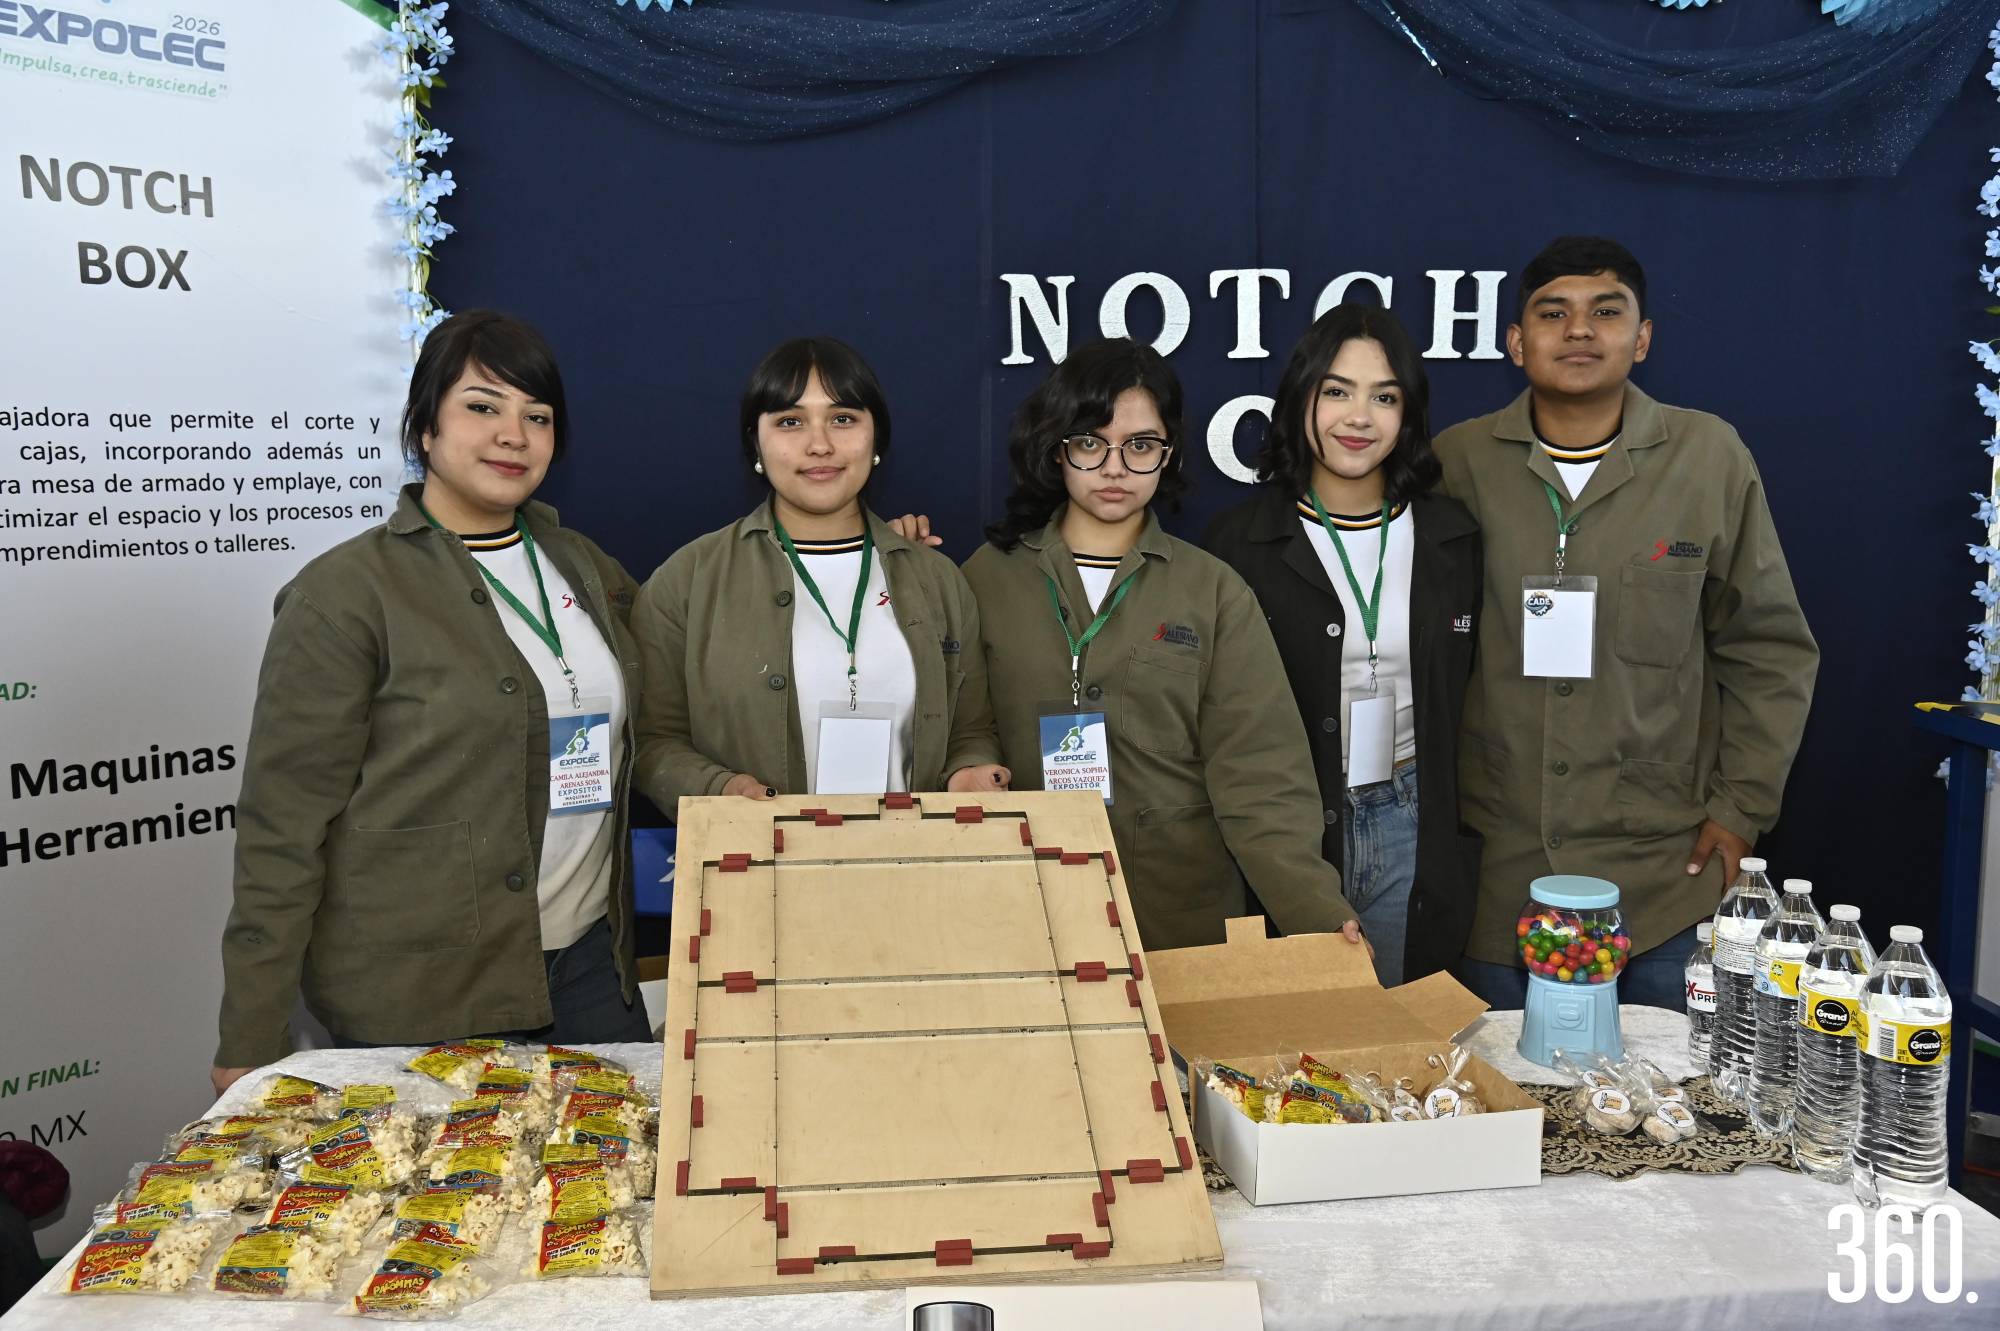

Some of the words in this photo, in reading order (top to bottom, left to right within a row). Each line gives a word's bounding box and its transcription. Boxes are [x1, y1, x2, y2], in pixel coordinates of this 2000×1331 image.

[172, 15, 220, 36] 2026
[0, 1, 226, 72] EXPOTEC
[0, 50, 77, 78] mpulsa,
[80, 66, 124, 85] crea,
[19, 153, 215, 218] NOTCH
[78, 241, 191, 292] BOX
[0, 406, 90, 433] ajadora
[109, 412, 152, 433] que
[170, 411, 254, 433] permite
[271, 411, 288, 430] el
[305, 414, 355, 431] corte
[370, 416, 381, 434] y
[20, 443, 87, 466] cajas,
[105, 441, 252, 467] incorporando
[267, 441, 344, 460] además
[358, 446, 381, 460] un
[32, 476, 95, 494] mesa
[105, 474, 133, 494] de
[141, 472, 225, 493] armado
[233, 476, 244, 496] y
[252, 472, 342, 495] emplaye,
[349, 475, 382, 490] con
[88, 506, 108, 527] el
[118, 504, 201, 528] espacio
[210, 507, 221, 527] y
[229, 503, 258, 523] los
[266, 503, 354, 526] procesos
[361, 504, 383, 519] en
[195, 539, 209, 554] o
[214, 533, 296, 554] talleres.
[559, 756, 600, 766] EXPOTEC
[1053, 753, 1097, 762] EXPOTEC
[10, 744, 236, 800] Maquinas
[550, 773, 574, 782] CAMILA
[575, 769, 609, 779] ALEJANDRA
[1044, 768, 1080, 776] VERONICA
[1073, 776, 1106, 784] VAZQUEZ
[558, 785, 602, 796] EXPOSITOR
[560, 781, 584, 789] ARENAS
[1053, 782, 1100, 790] EXPOSITOR
[0, 802, 236, 868] Herramien
[1816, 1009, 1848, 1022] Grand
[1910, 1039, 1941, 1050] Grand
[27, 1059, 101, 1091] FINAL:
[31, 1110, 88, 1147] MX
[163, 1210, 179, 1219] 10g
[315, 1212, 330, 1220] 10g
[85, 1243, 145, 1263] PALOMITAS
[584, 1248, 600, 1256] 10g
[120, 1277, 138, 1285] 10g
[373, 1277, 425, 1294] PALOMITAS
